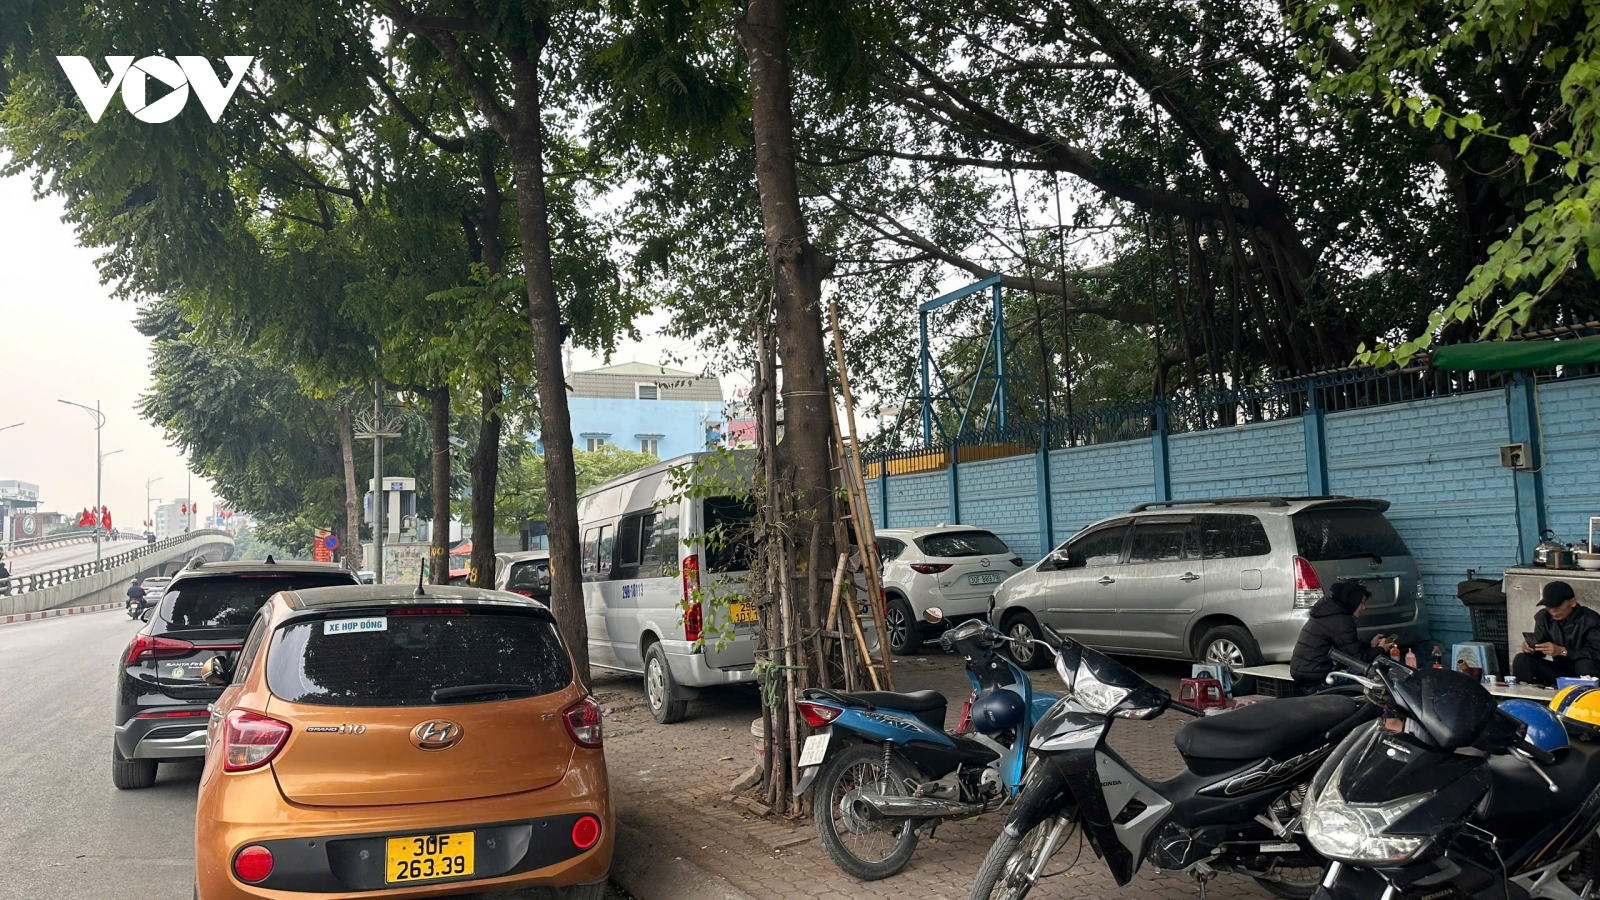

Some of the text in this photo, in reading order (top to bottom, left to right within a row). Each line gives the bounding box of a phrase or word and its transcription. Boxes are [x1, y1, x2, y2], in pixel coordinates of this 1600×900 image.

[341, 622, 358, 631] HỢP
[413, 835, 450, 856] 30F
[396, 856, 465, 880] 263.39
